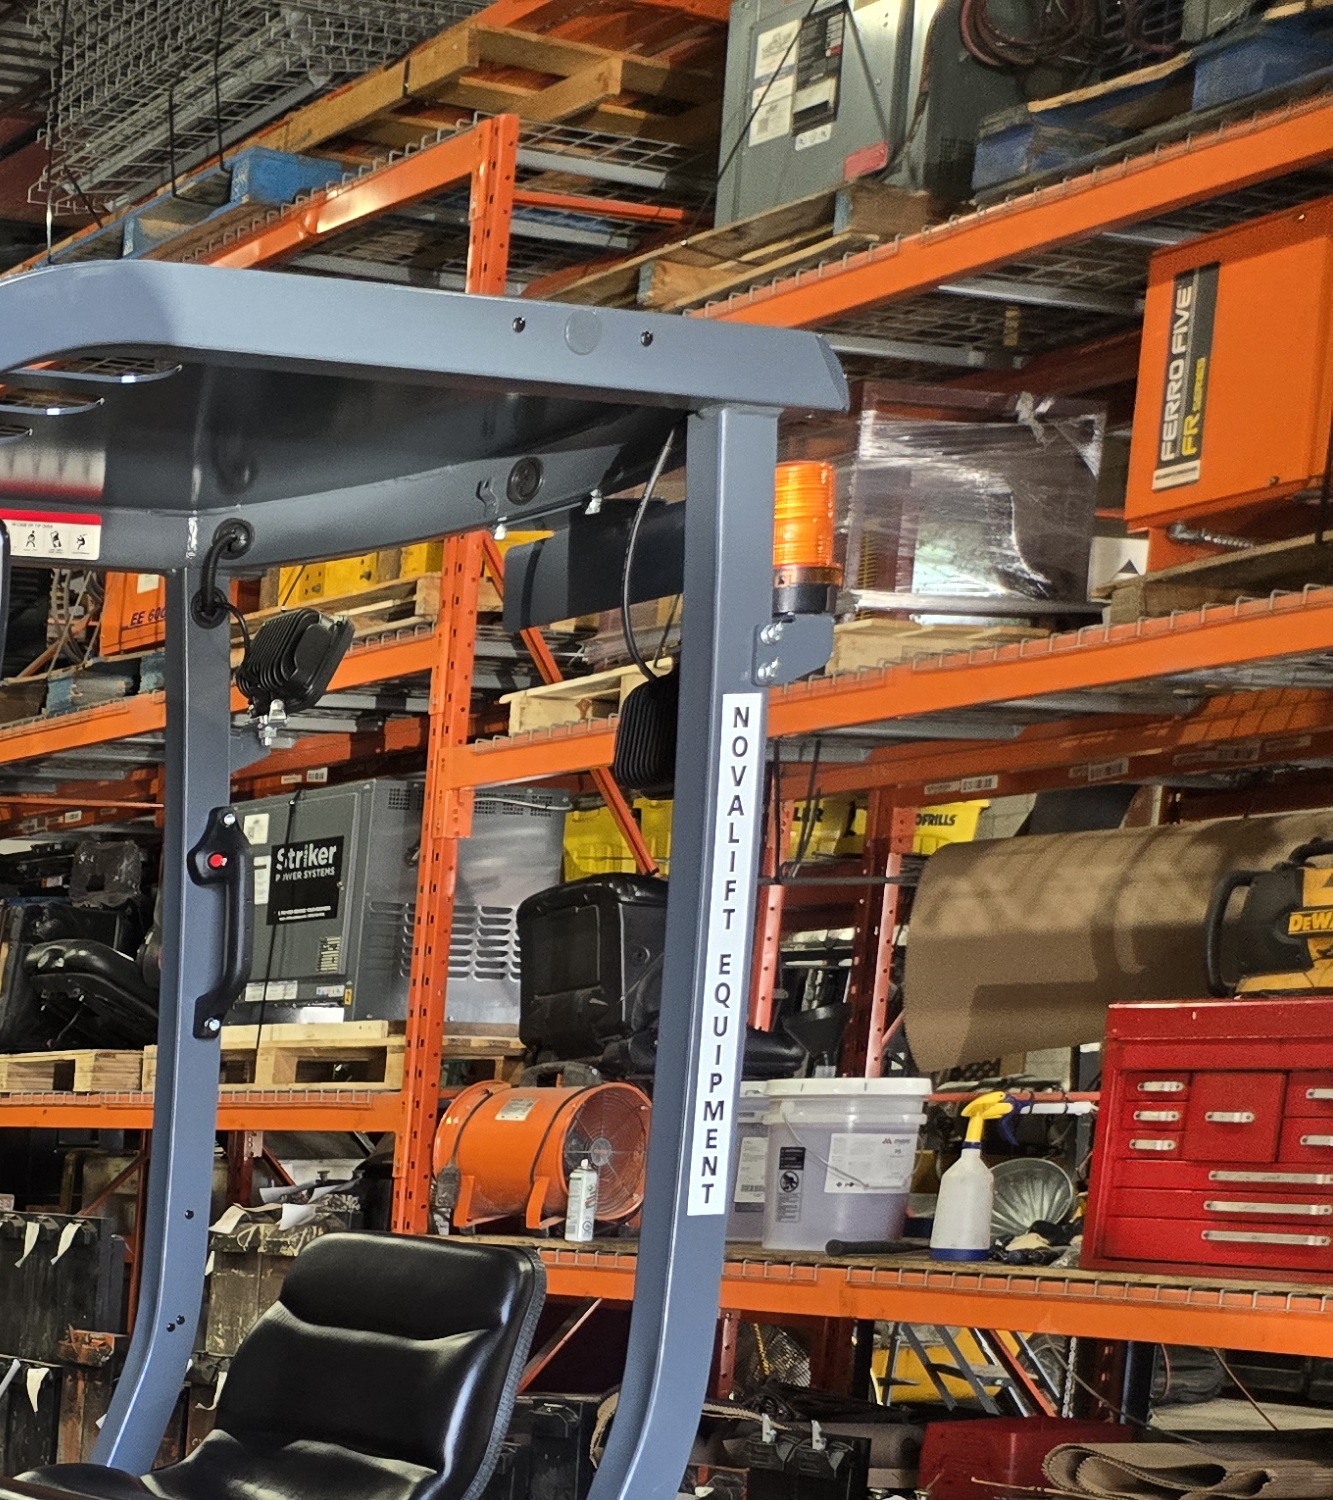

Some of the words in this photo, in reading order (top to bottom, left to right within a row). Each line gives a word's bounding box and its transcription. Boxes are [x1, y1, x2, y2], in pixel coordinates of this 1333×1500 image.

[1161, 359, 1184, 462] FERRO
[1173, 283, 1192, 354] FIVE
[1182, 413, 1199, 456] FR
[130, 610, 147, 626] EE
[721, 706, 750, 931] NOVALIFT
[275, 871, 302, 882] PWER
[303, 866, 336, 879] SYSTEMS
[276, 843, 337, 871] Striker
[699, 952, 732, 1206] EQUIPMENT
